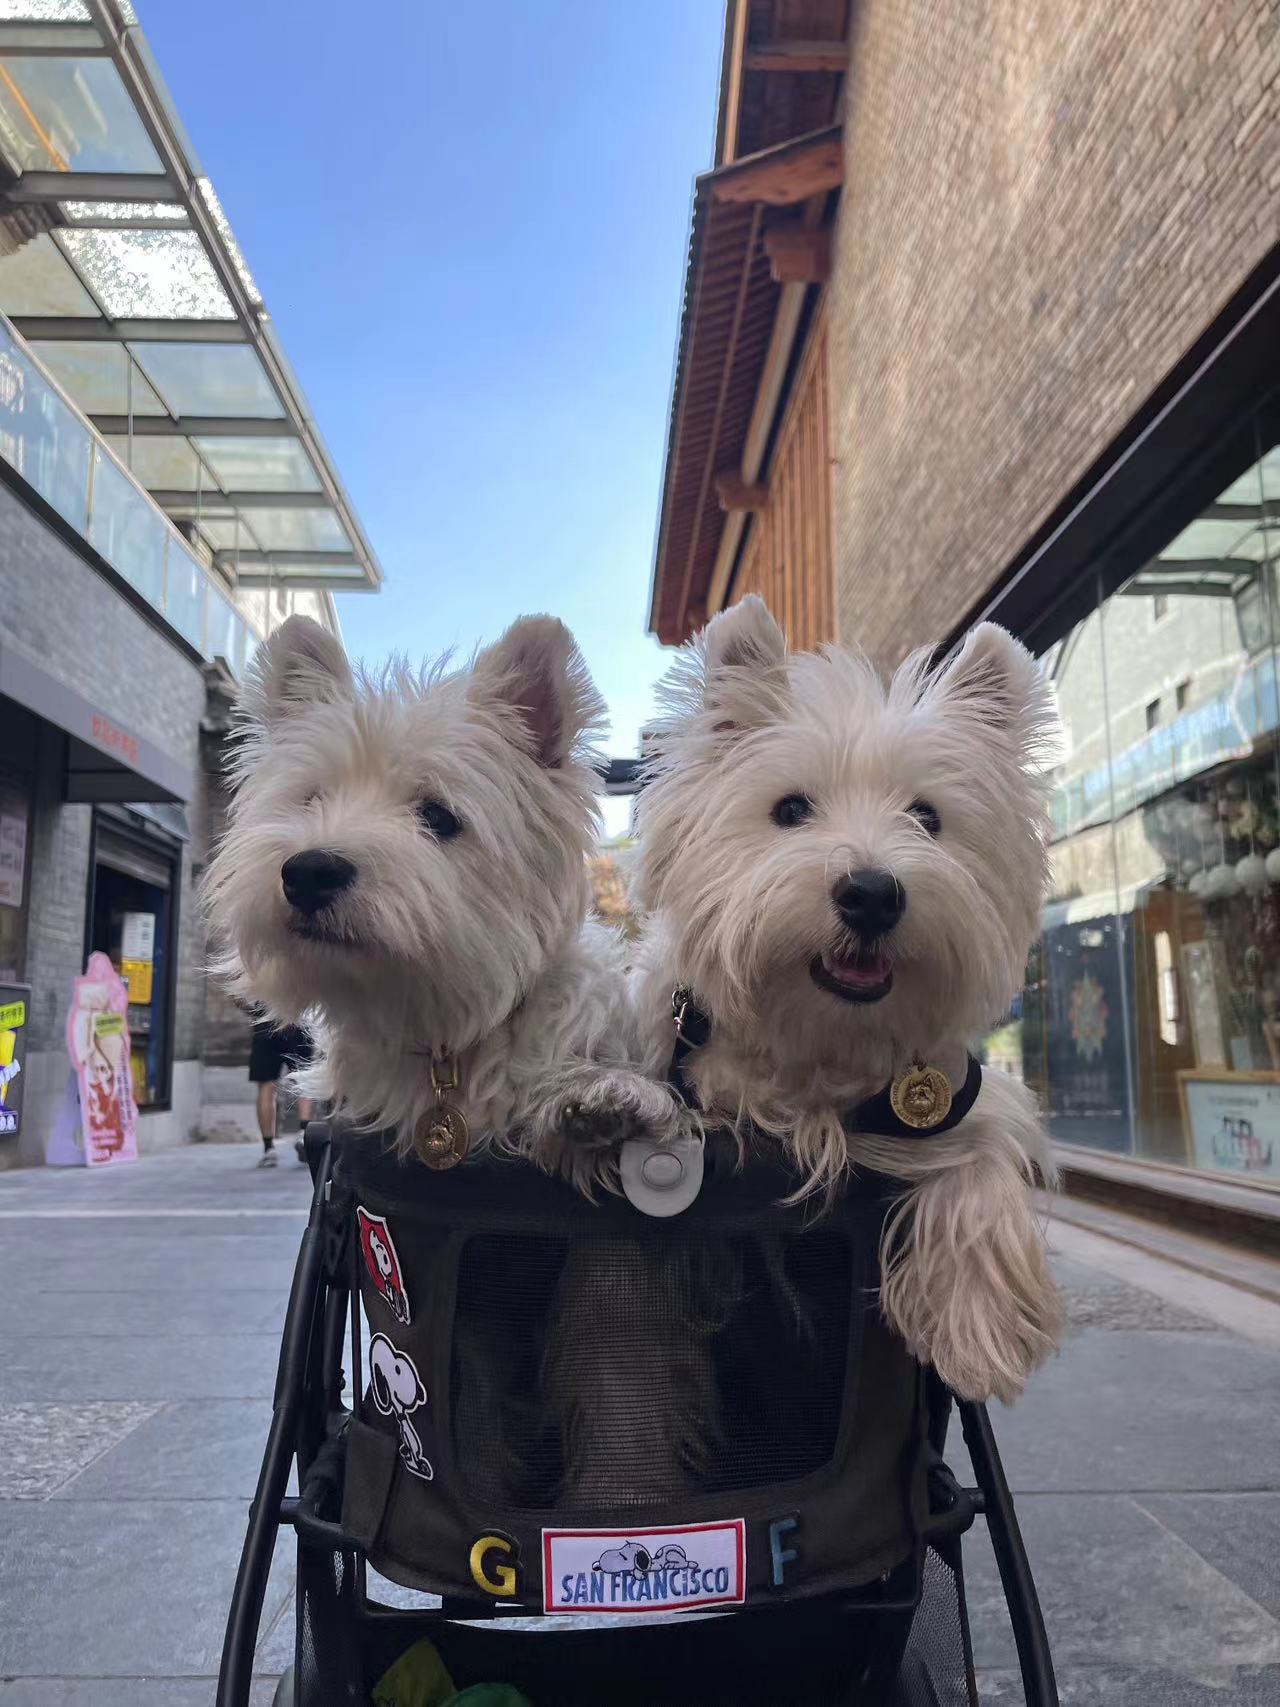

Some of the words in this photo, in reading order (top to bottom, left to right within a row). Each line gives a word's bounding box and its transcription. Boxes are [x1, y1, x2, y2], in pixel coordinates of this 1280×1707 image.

[469, 1536, 516, 1596] G
[769, 1518, 798, 1586] F
[561, 1572, 605, 1604] SAN
[611, 1566, 729, 1603] FRANCISCO
